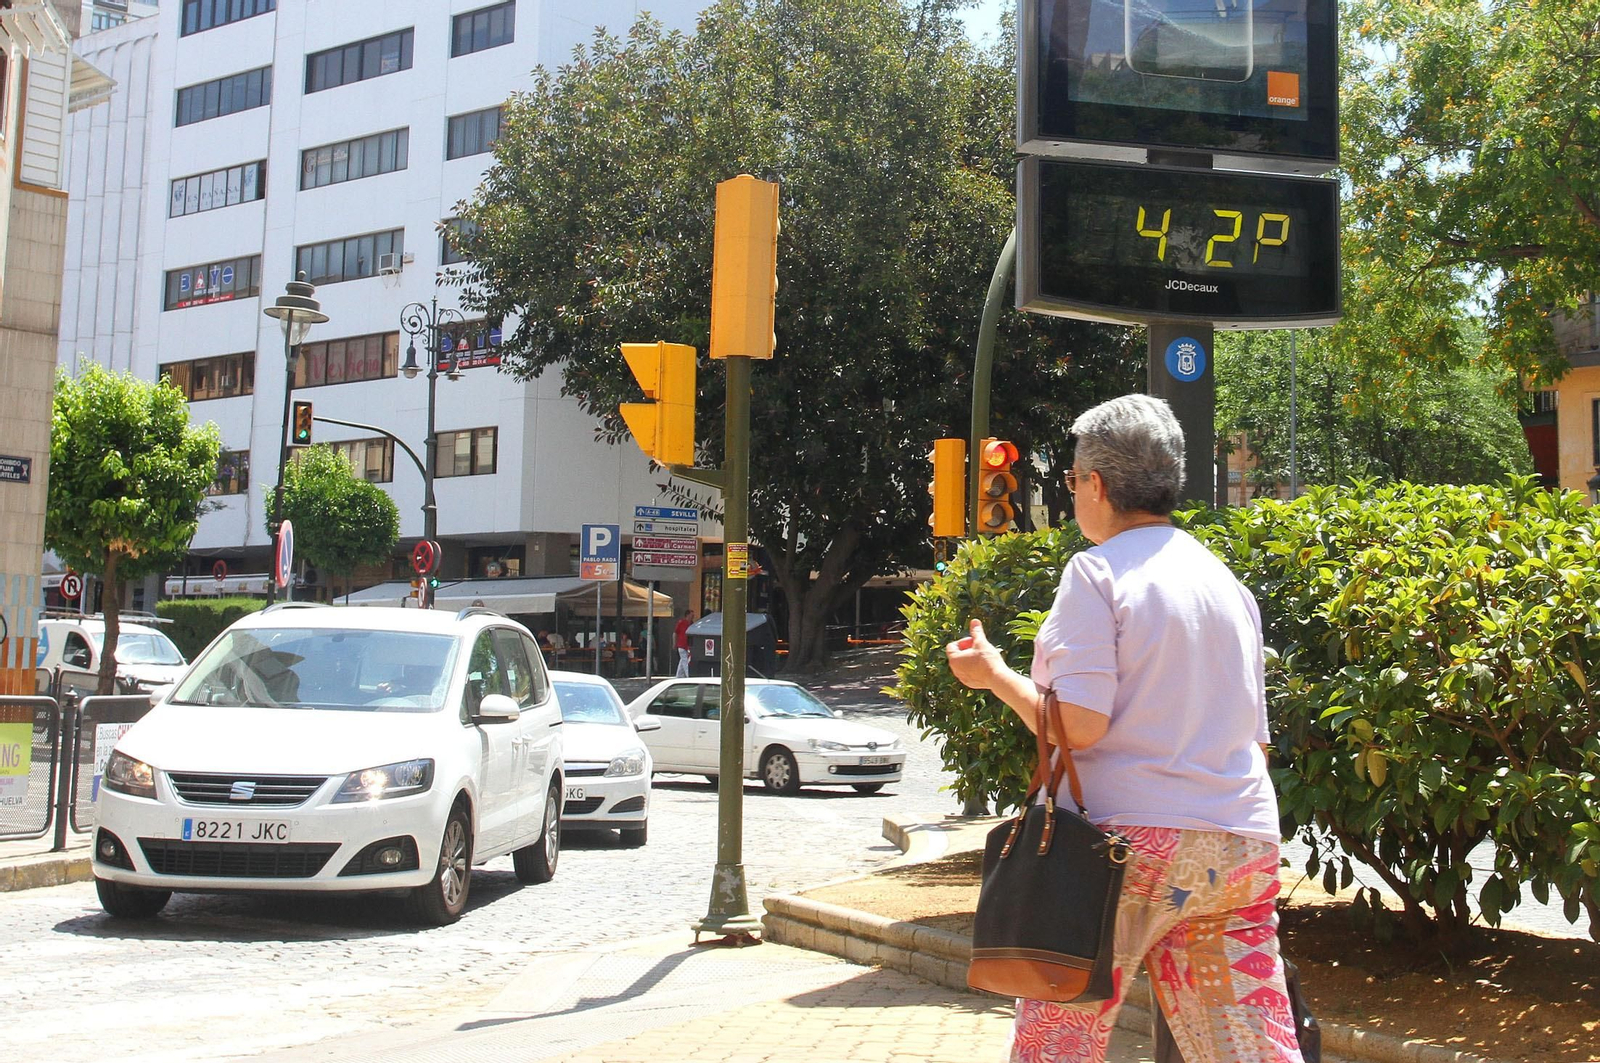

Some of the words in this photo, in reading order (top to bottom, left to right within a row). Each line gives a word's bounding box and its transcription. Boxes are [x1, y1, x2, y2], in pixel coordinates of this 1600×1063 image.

[1269, 97, 1296, 106] orange
[181, 265, 234, 292] BAYO
[1164, 279, 1218, 293] JCDecaux
[589, 527, 612, 555] P
[196, 821, 242, 839] 8221
[251, 823, 288, 840] JKC
